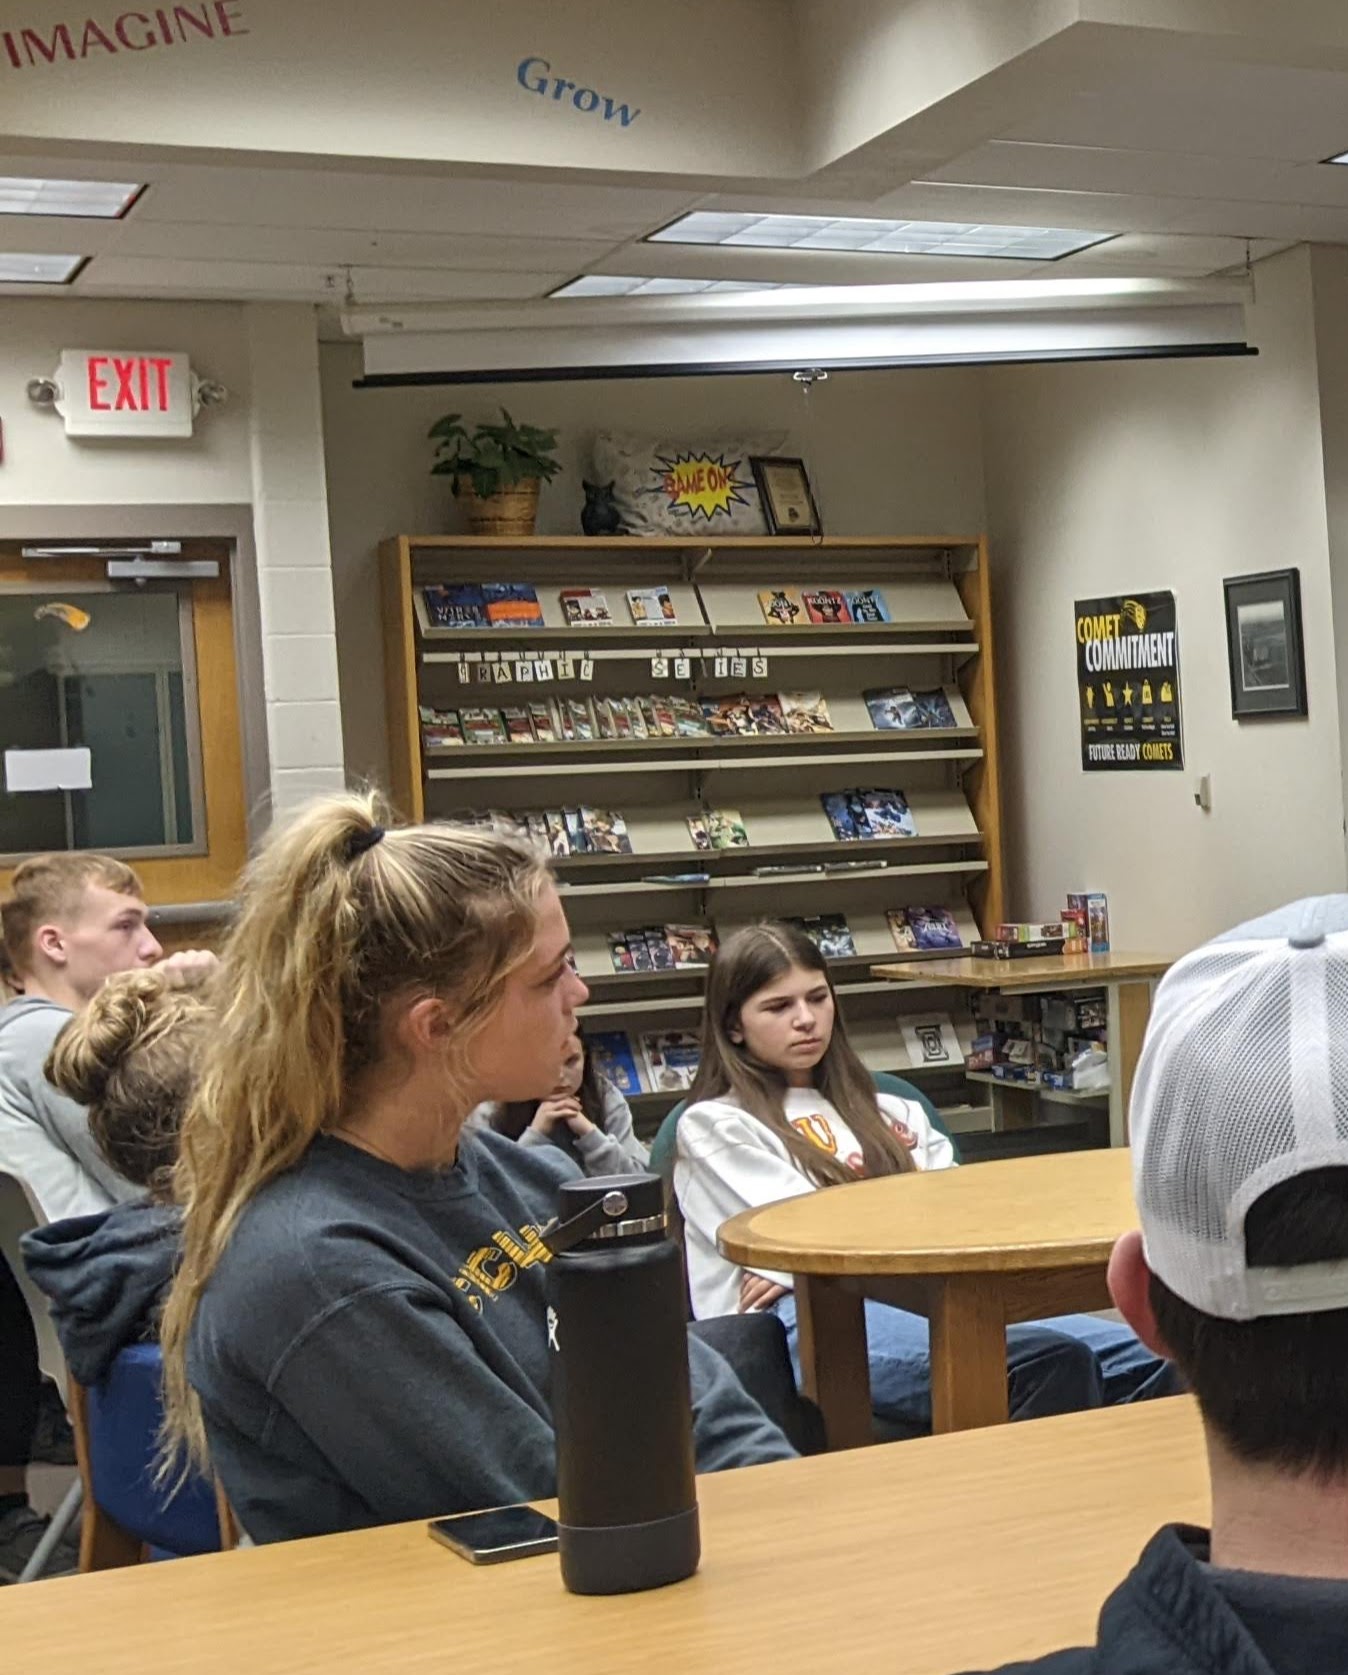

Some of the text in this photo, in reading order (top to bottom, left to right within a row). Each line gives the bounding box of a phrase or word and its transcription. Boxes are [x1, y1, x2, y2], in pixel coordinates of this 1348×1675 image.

[2, 0, 250, 69] IMAGINE
[517, 56, 642, 127] Grow
[87, 356, 172, 412] EXIT
[1077, 614, 1121, 644] COMET
[652, 659, 766, 679] SEIES
[1085, 631, 1174, 672] COMMITMENT
[1088, 742, 1174, 761] FUTURE READY COMETS
